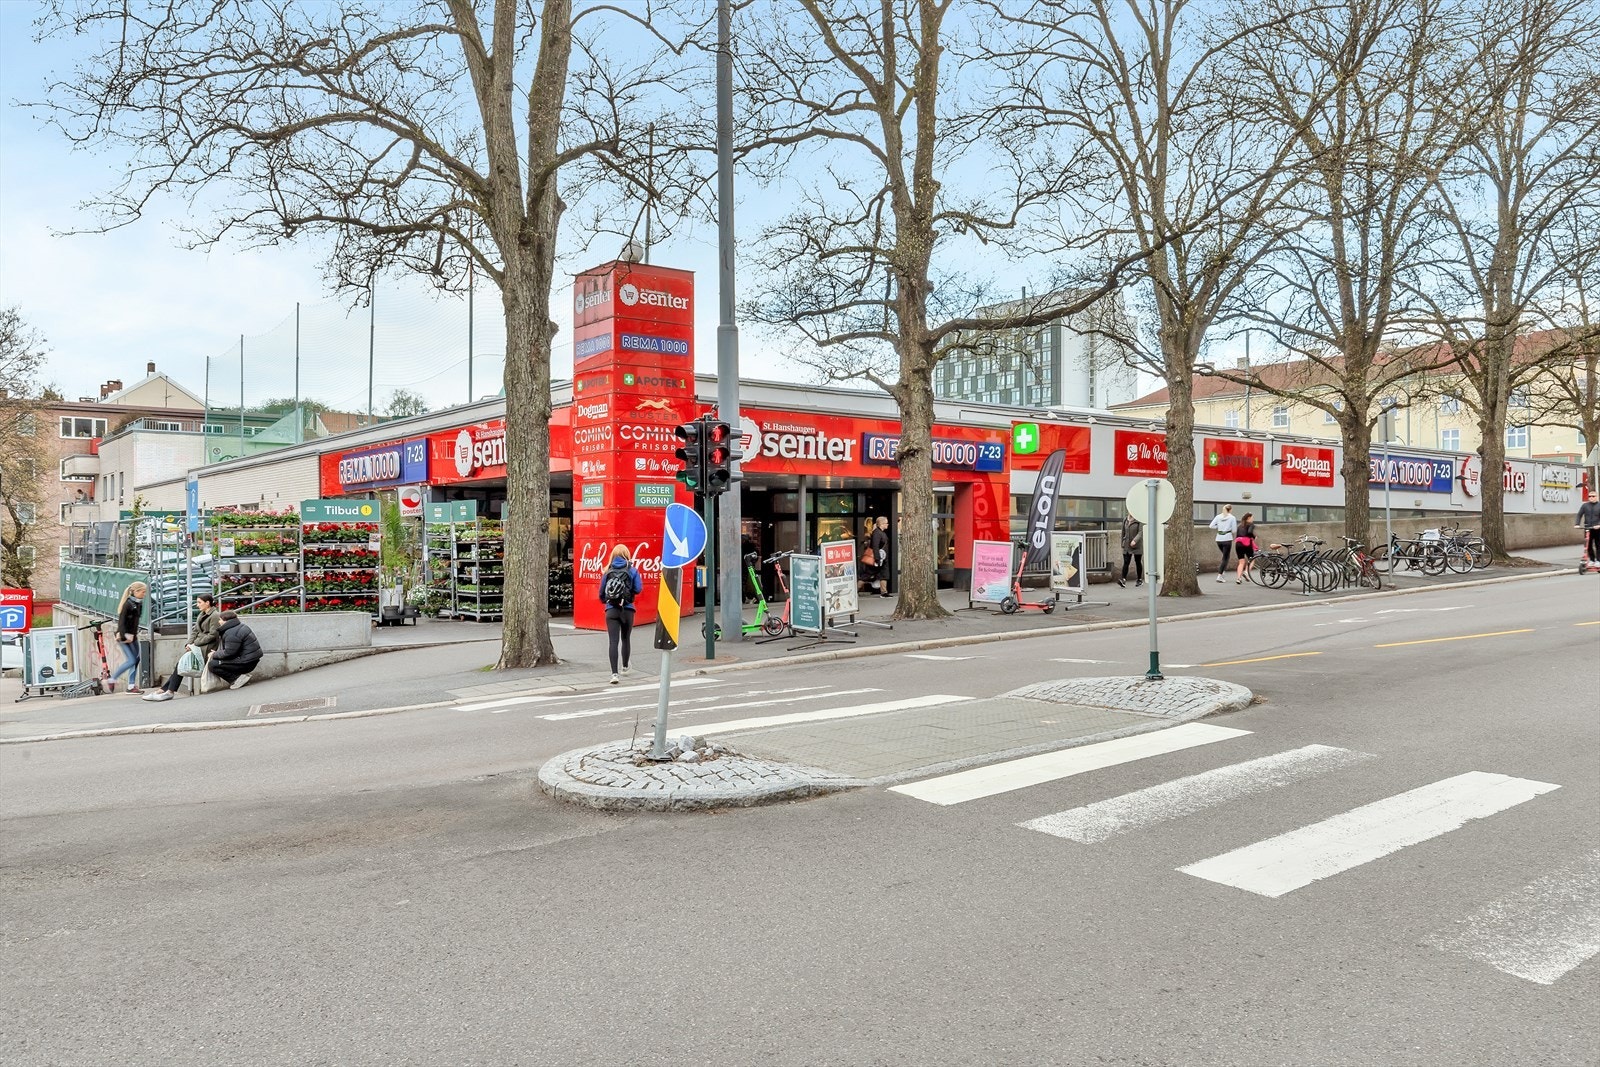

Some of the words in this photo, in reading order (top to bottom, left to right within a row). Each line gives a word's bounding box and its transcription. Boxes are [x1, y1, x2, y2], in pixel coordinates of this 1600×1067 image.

[585, 290, 612, 309] senter
[639, 292, 689, 310] senter
[576, 340, 595, 356] REMA
[595, 336, 611, 351] 1000
[622, 335, 658, 351] REMA
[661, 340, 688, 353] 1000
[636, 376, 678, 388] APOTEK
[680, 379, 686, 388] 1
[578, 403, 608, 419] Dogman
[630, 411, 678, 420] BUSTER
[574, 425, 612, 444] COMINO
[773, 423, 816, 435] Hanshaugen
[474, 431, 507, 468] sent
[582, 443, 605, 452] FRISØR
[634, 443, 676, 451] FRISØR
[763, 431, 856, 461] senter
[869, 436, 900, 459] RE
[932, 441, 977, 465] 1000
[978, 445, 1001, 459] 7-23
[1152, 444, 1167, 464] Ren
[1218, 455, 1253, 468] APOTEK
[1254, 457, 1259, 468] 1
[338, 456, 369, 485] REMA
[370, 451, 400, 480] 1000
[406, 444, 424, 463] 7-23
[647, 459, 659, 471] Ila
[661, 459, 679, 474] Rens
[1285, 453, 1330, 474] Dogman
[1317, 470, 1331, 478] friends
[1369, 458, 1399, 483] EMA
[1399, 461, 1432, 486] 1000
[1433, 463, 1451, 479] 7-23
[1503, 465, 1530, 493] nter
[584, 486, 601, 494] MESTER
[640, 486, 670, 494] MESTER
[585, 497, 601, 505] GRØNN
[640, 496, 669, 505] GRØNN
[324, 505, 359, 516] Tilbud
[402, 508, 422, 516] posten
[579, 542, 608, 578] fresh
[630, 542, 662, 572] fres
[583, 572, 601, 580] FITNESS
[7, 613, 18, 627] P
